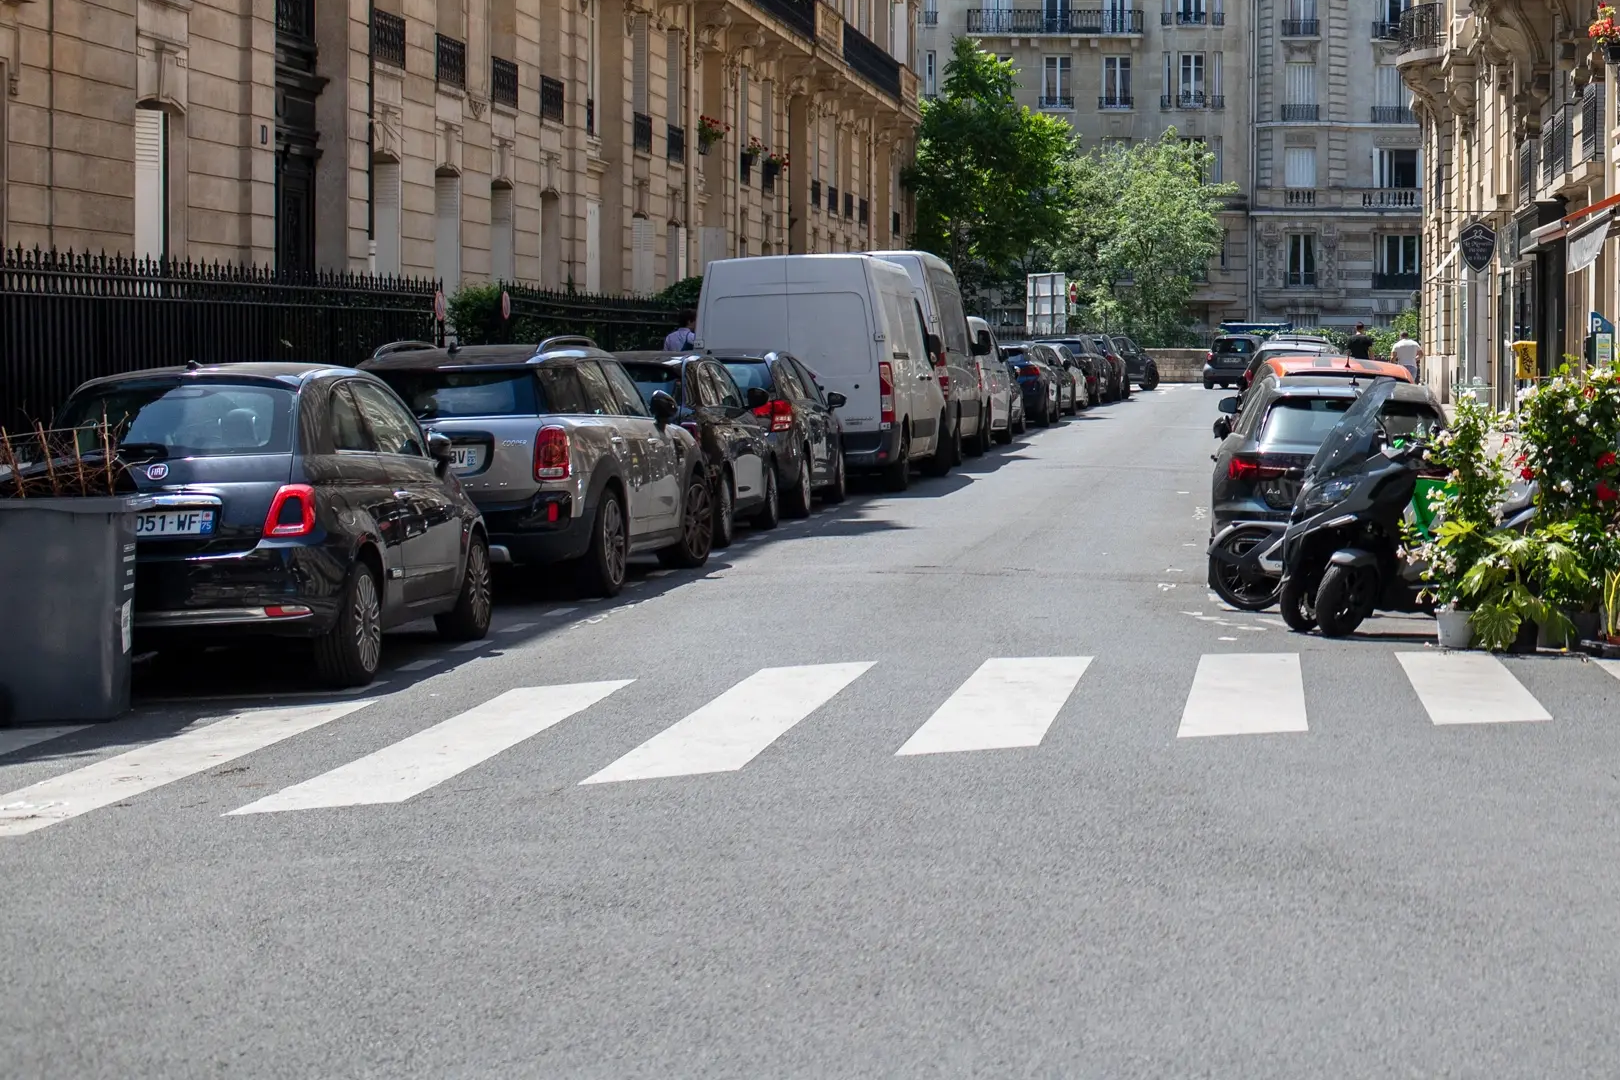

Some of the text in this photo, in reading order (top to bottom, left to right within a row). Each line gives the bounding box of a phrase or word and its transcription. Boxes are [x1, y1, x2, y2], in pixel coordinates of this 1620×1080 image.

[502, 439, 527, 447] COOPER
[151, 467, 165, 476] FIAT
[201, 521, 212, 530] 75
